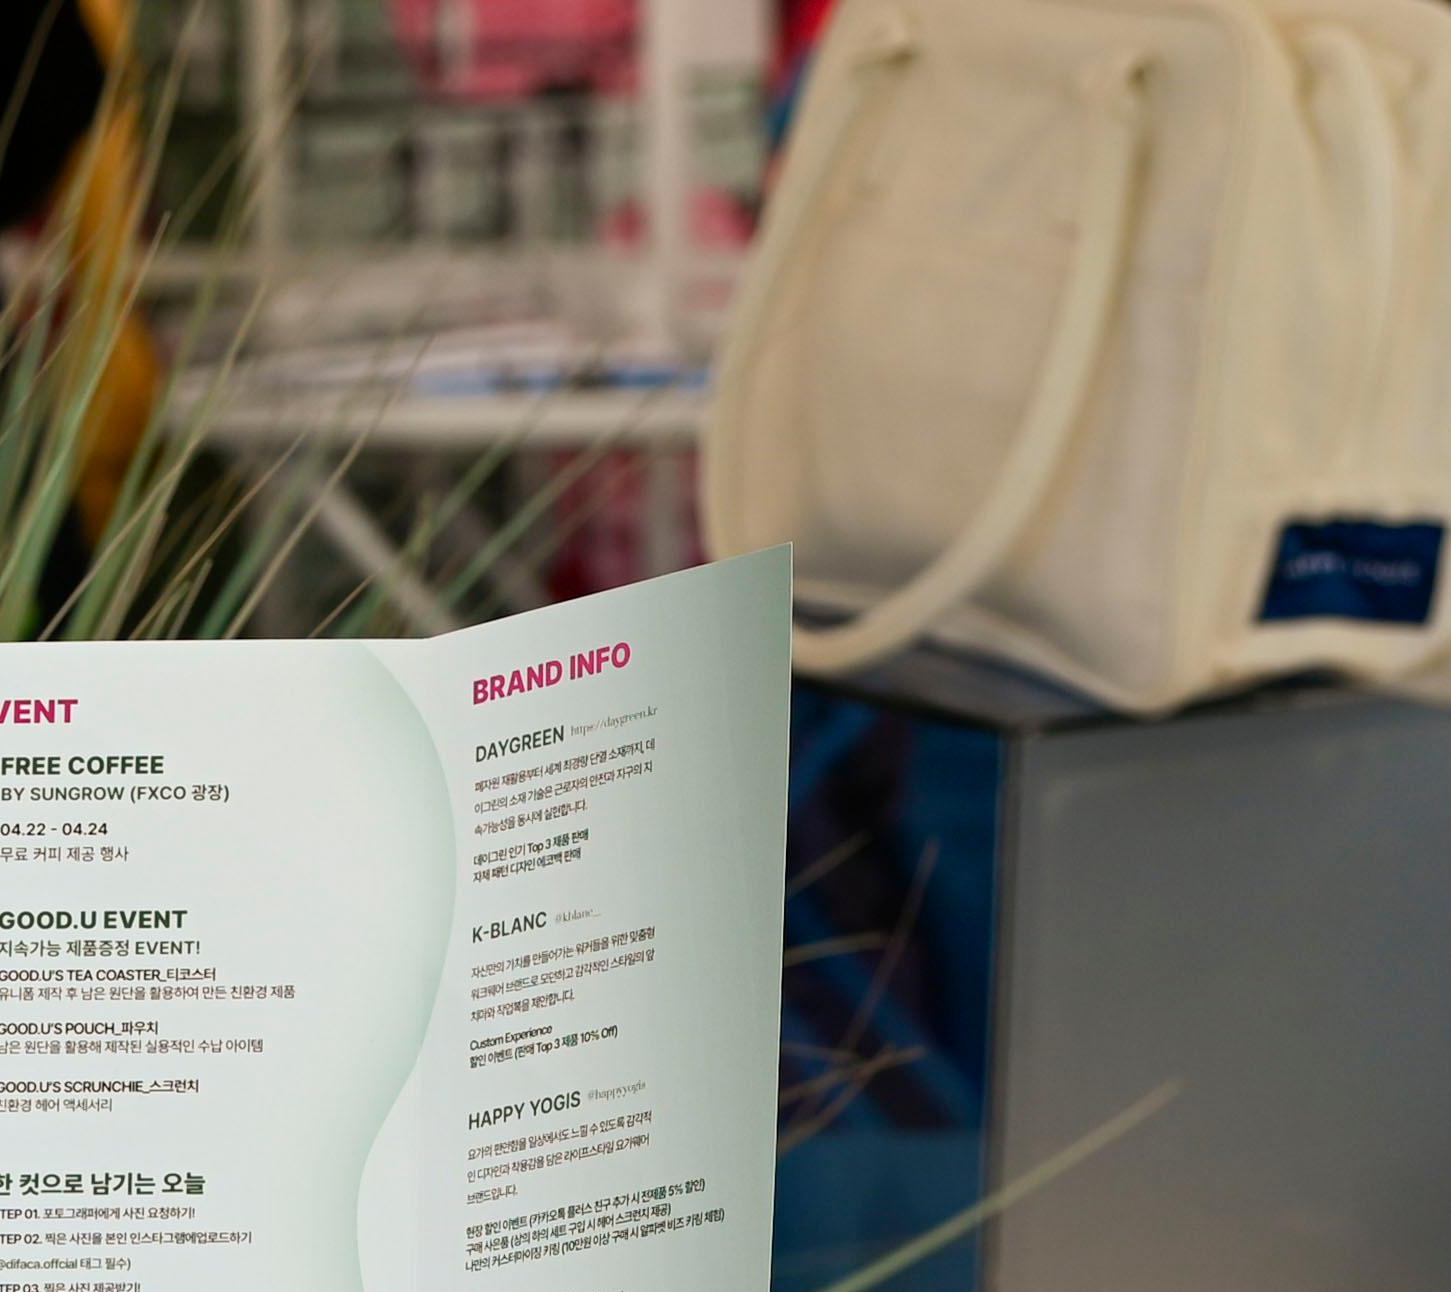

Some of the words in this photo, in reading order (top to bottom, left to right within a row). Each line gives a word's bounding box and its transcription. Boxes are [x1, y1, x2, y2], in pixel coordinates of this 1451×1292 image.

[472, 660, 563, 705] BRAND
[569, 642, 631, 680] INFO
[475, 725, 565, 762] DAYGREEN
[1, 757, 61, 775] FREE
[68, 755, 164, 775] COFFEE
[1, 788, 24, 801] BY
[30, 787, 124, 801] SUNGROW
[130, 786, 186, 803] (FXCO
[191, 784, 230, 803] 광장)
[0, 823, 46, 836] 04.22
[62, 823, 108, 836] 04.24
[0, 848, 28, 862] 무료
[33, 847, 62, 862] 커피
[67, 847, 94, 862] 제공
[100, 846, 129, 862] 행사
[103, 910, 188, 928] EVENT
[472, 911, 547, 943] K-BLANC
[66, 939, 129, 957] 제품증정
[135, 940, 200, 955] EVENT!
[67, 969, 92, 981] TEA
[468, 1102, 525, 1130] HAPPY
[530, 1090, 581, 1119] YOGIS
[18, 1173, 84, 1196] 컷으로
[90, 1172, 156, 1196] 남기는
[162, 1172, 206, 1195] 오늘
[24, 1208, 40, 1219] 01.
[123, 1207, 144, 1219] 사진
[147, 1207, 195, 1219] 요청하기!
[80, 1257, 102, 1270] 태그
[104, 1257, 131, 1271] 필수)
